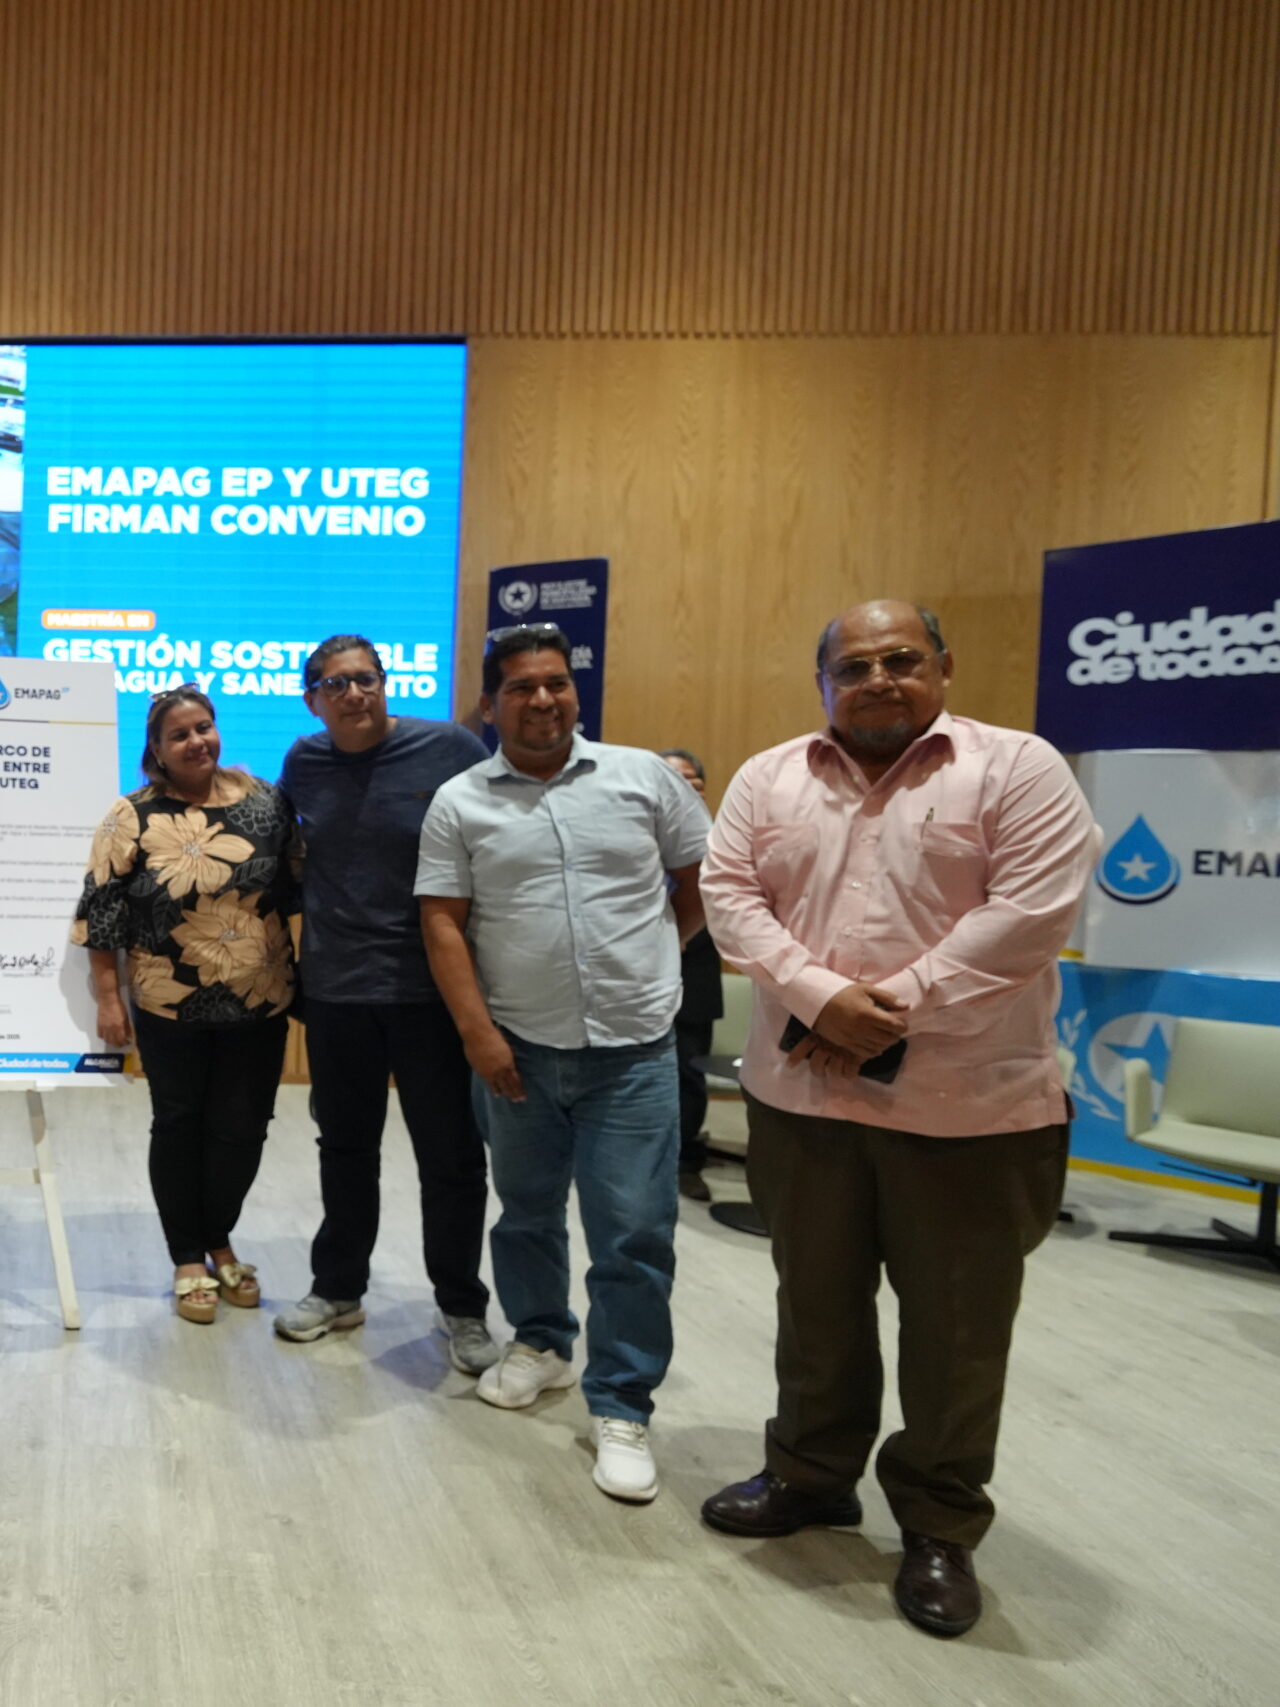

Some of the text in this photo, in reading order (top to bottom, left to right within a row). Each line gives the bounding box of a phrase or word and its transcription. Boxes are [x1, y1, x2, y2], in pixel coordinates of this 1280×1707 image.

[47, 466, 430, 499] EMAPAG EP Y UTEG
[48, 503, 426, 537] FIRMAN CONVENIO
[1068, 598, 1280, 657] Ciudad
[43, 632, 201, 668] GESTIÓN
[14, 687, 61, 701] EMAPAG
[194, 671, 216, 694] Y
[31, 746, 51, 758] DE
[3, 761, 51, 774] ENTRE
[0, 777, 40, 790] UTEG
[1192, 848, 1280, 879] EMA
